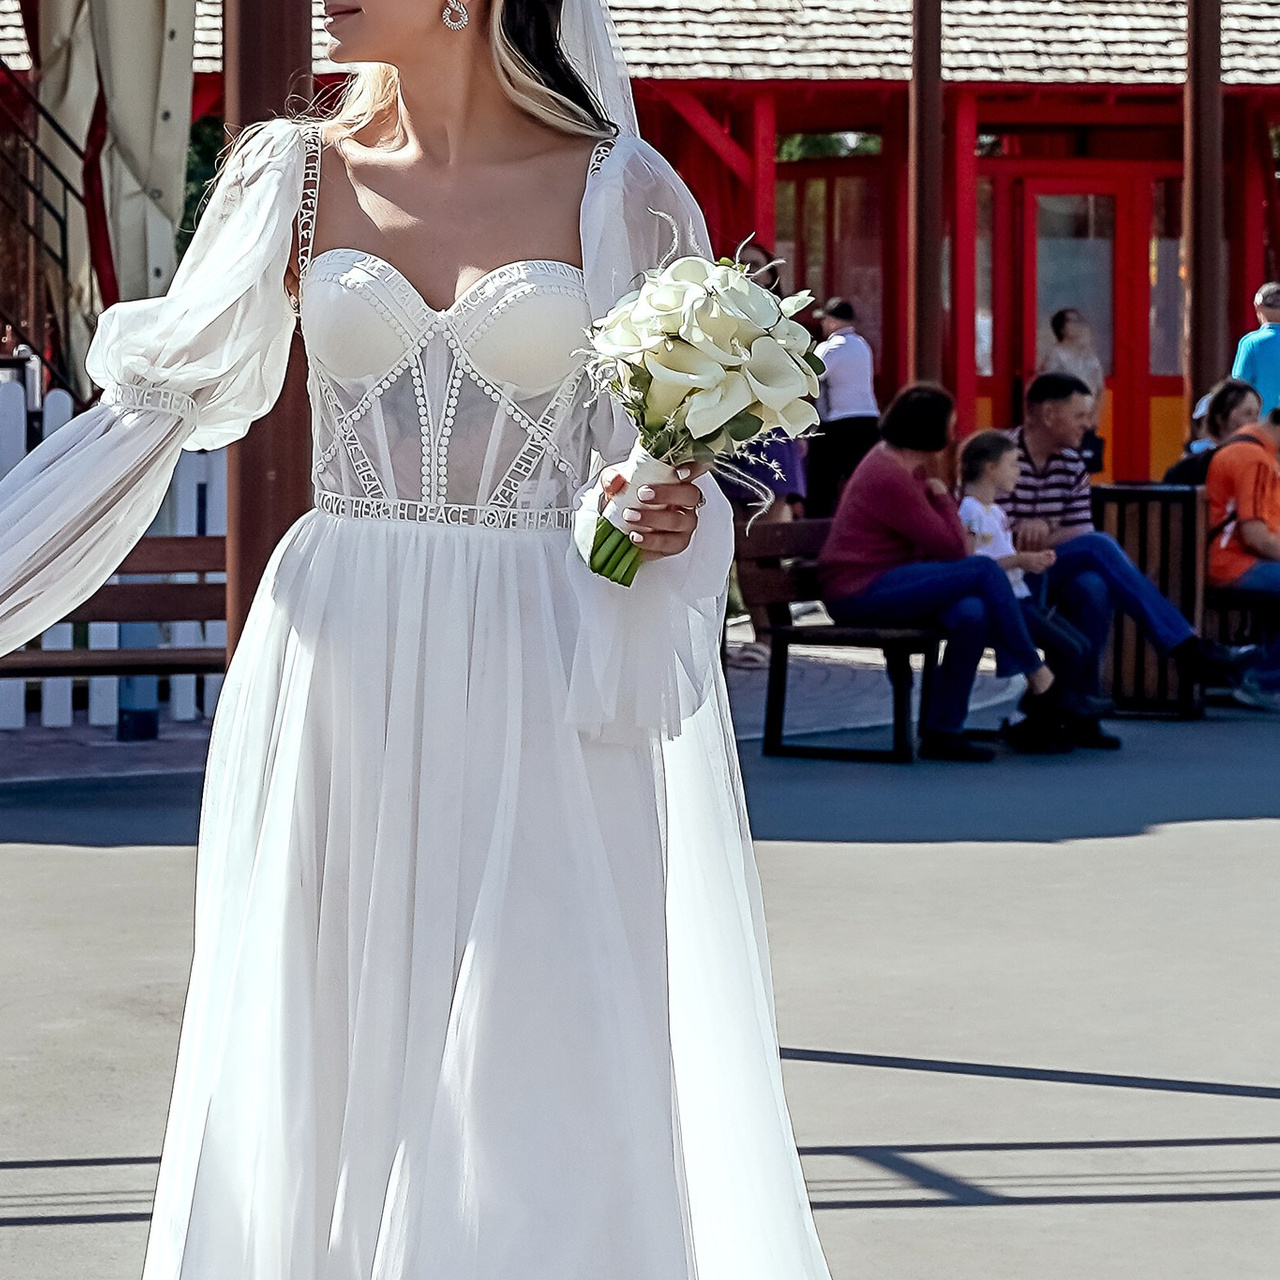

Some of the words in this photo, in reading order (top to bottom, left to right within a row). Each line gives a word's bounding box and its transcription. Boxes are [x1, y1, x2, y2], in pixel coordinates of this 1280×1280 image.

[299, 189, 317, 239] PEACE
[513, 413, 556, 477] HALTH
[320, 493, 346, 517] LOVE
[416, 504, 470, 525] PEACE
